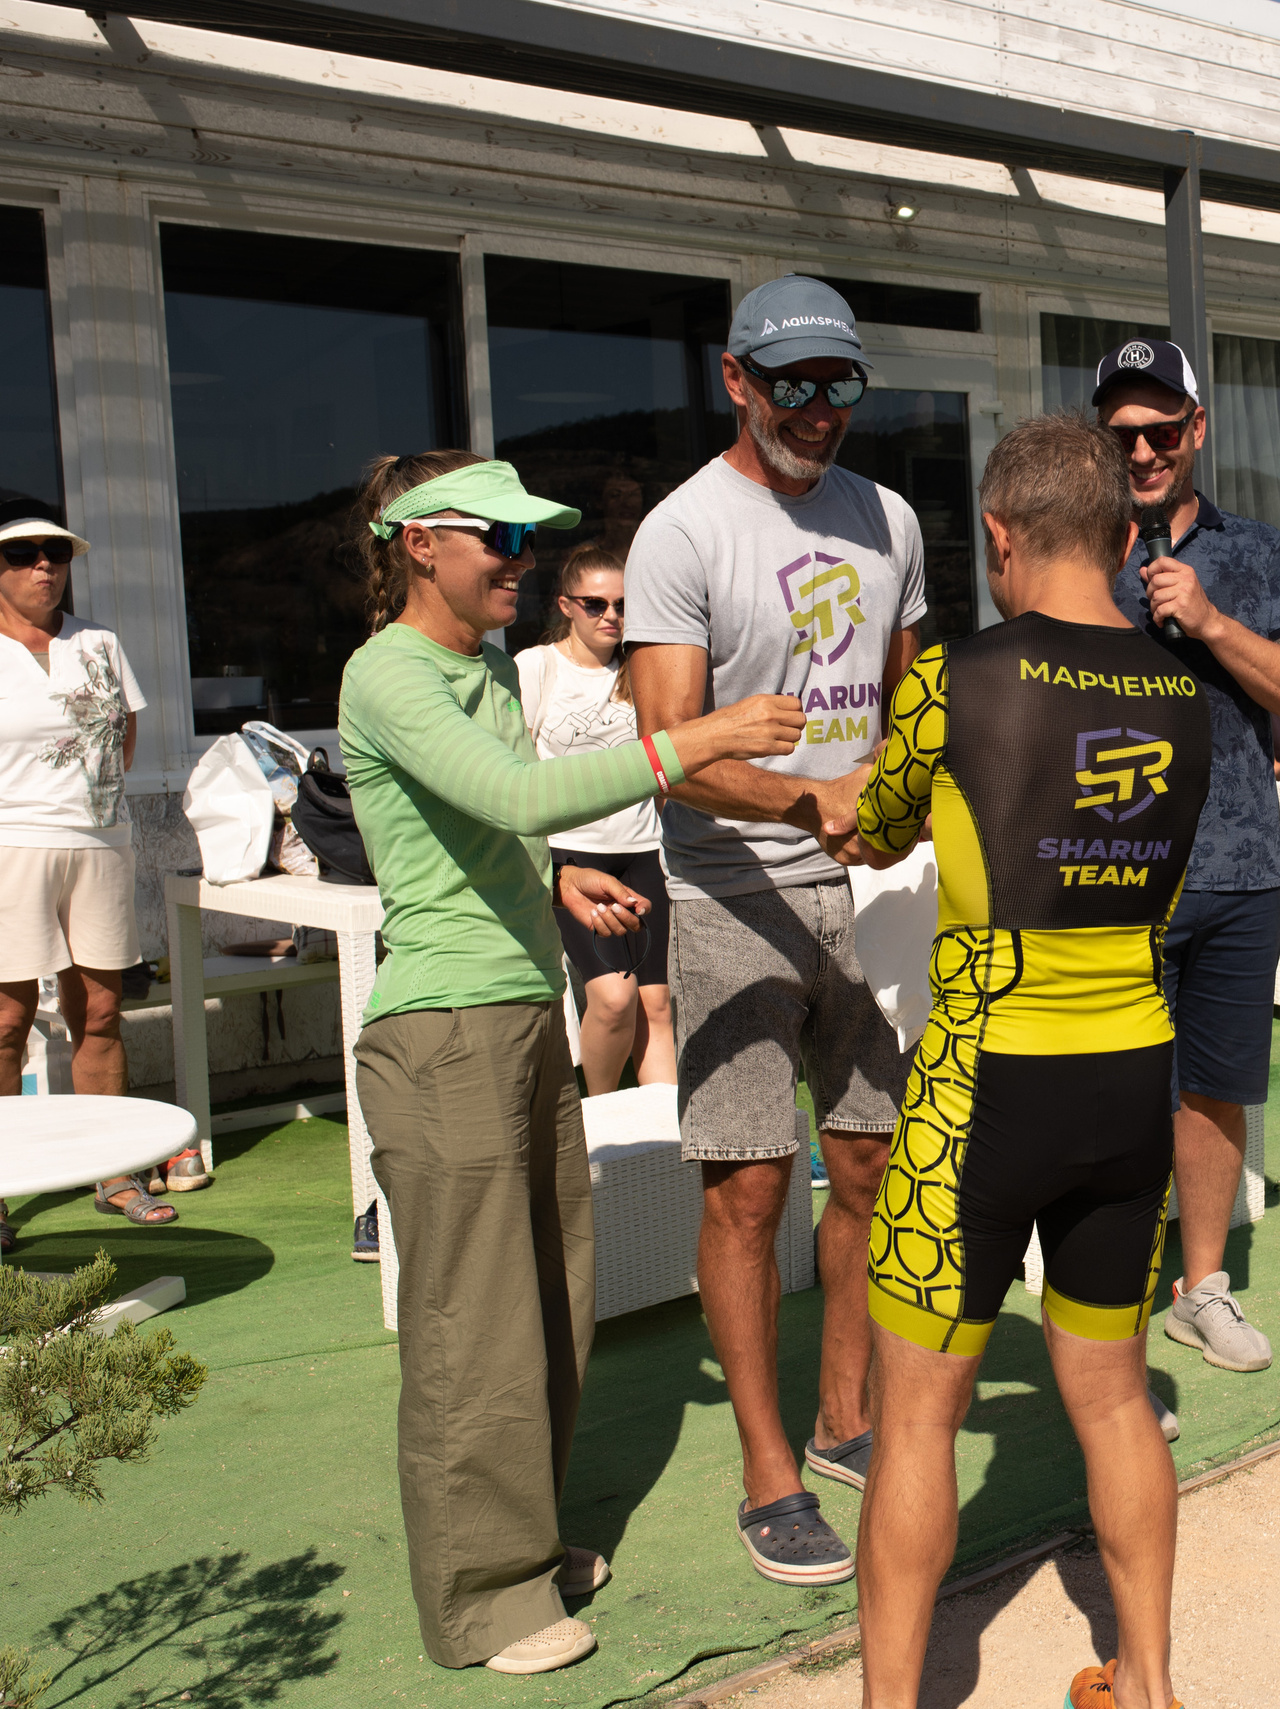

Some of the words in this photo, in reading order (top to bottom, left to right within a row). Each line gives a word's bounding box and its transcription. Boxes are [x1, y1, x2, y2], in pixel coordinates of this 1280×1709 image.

[1020, 659, 1196, 696] МАРЧЕНКО
[775, 682, 882, 713] ARUN
[794, 715, 868, 746] EAM
[1037, 838, 1172, 861] SHARUN
[1059, 865, 1149, 887] TEAM
